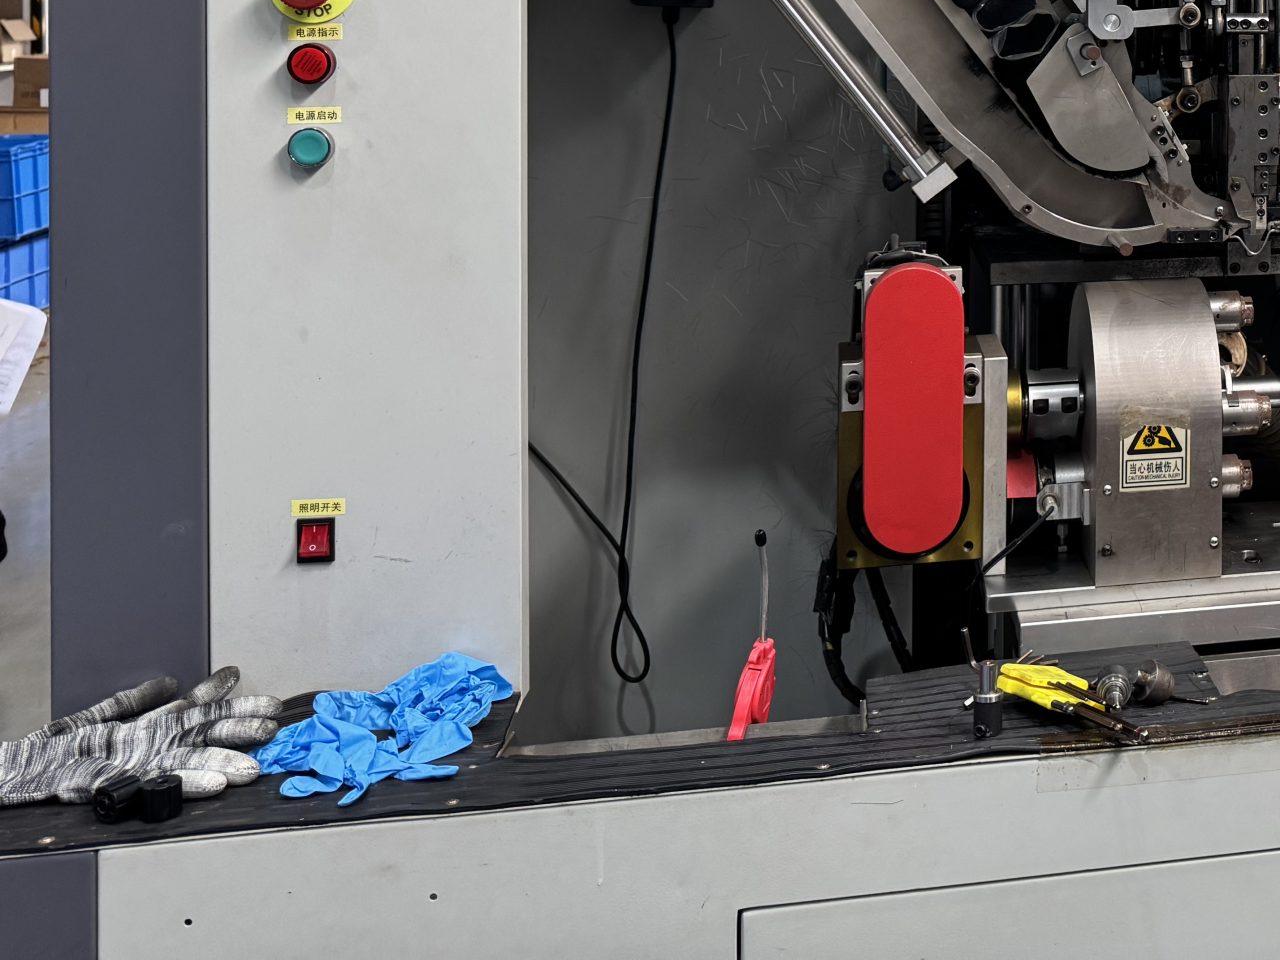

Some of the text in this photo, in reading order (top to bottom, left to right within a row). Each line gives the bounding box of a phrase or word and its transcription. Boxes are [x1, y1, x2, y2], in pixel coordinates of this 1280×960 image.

[296, 27, 339, 37] 电源指示
[295, 109, 338, 121] 电源启动
[1129, 459, 1181, 475] 当心机械伤人
[299, 502, 342, 513] 照明开关
